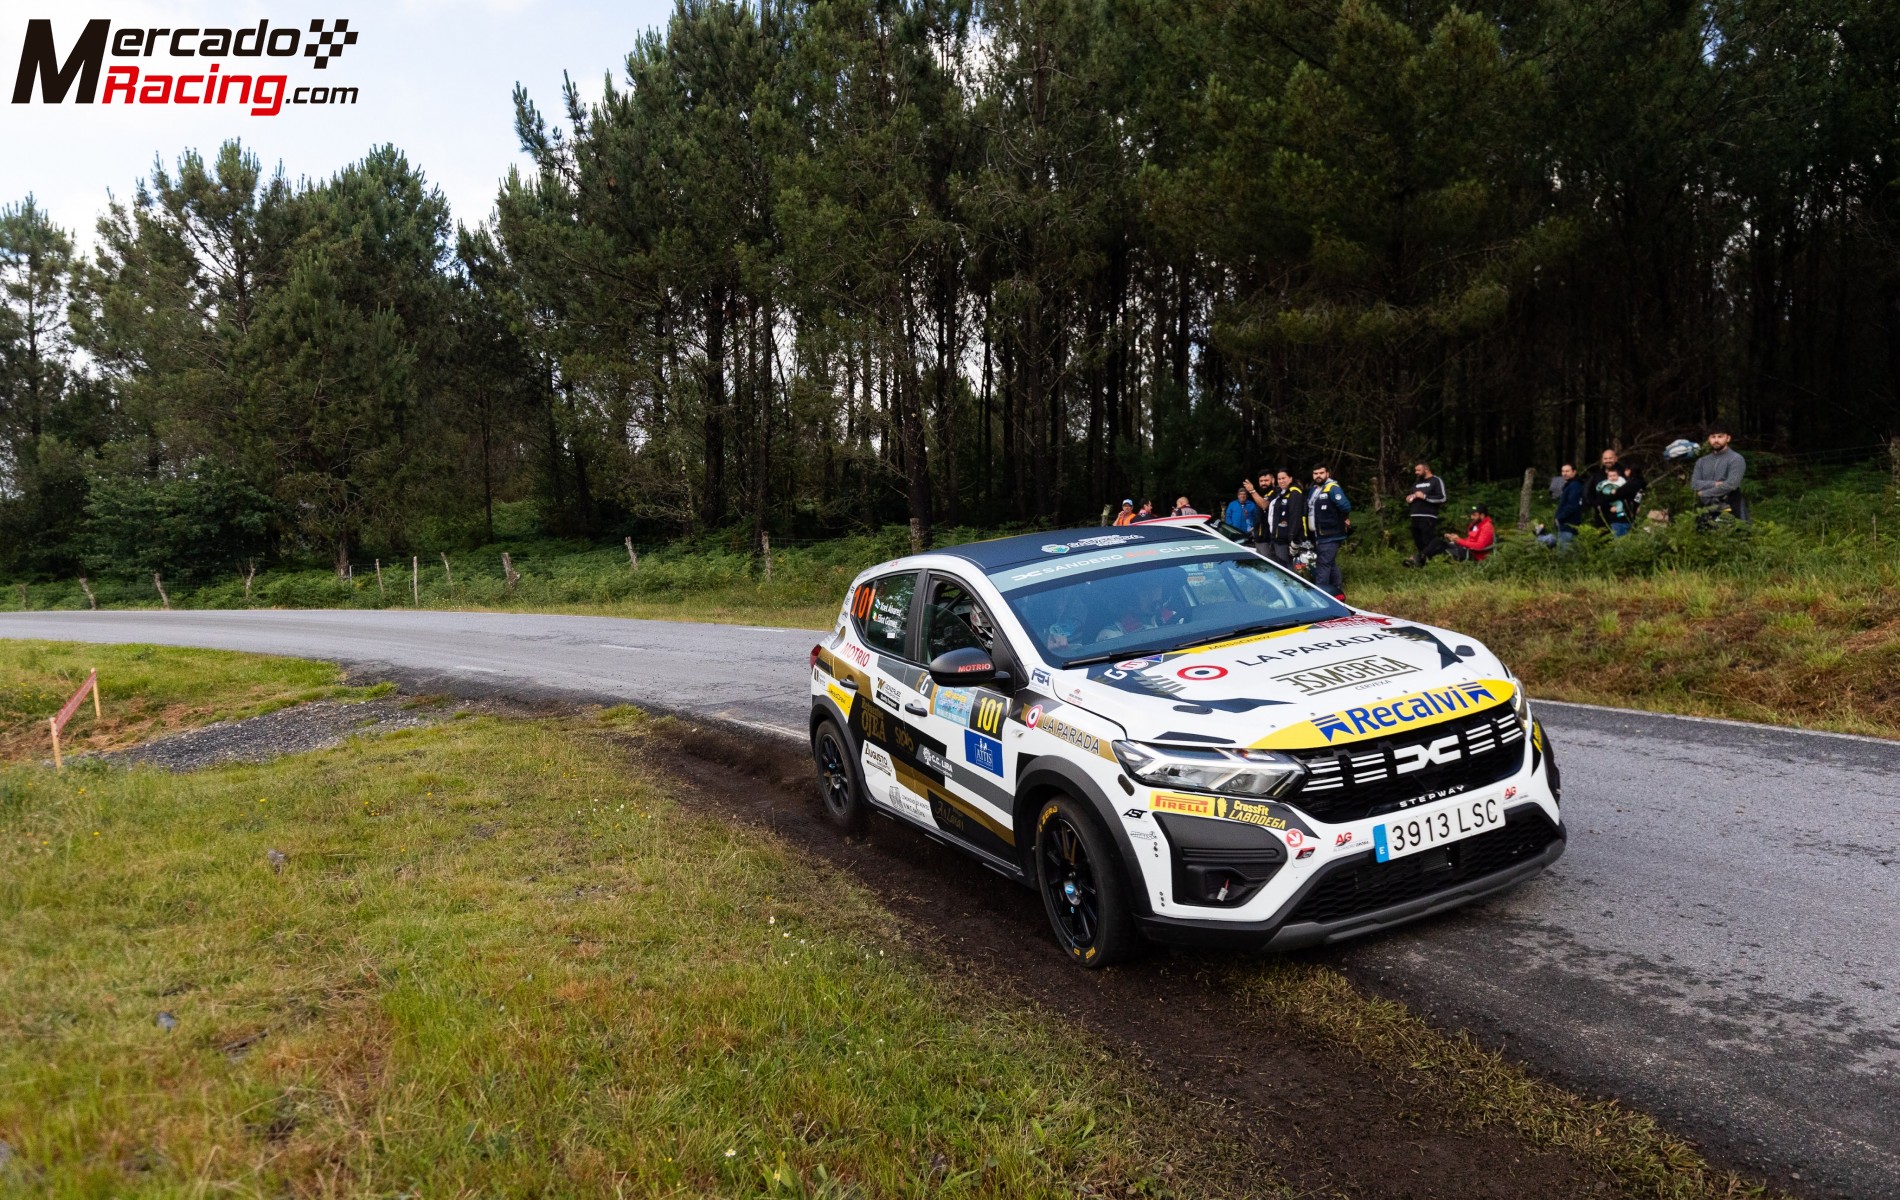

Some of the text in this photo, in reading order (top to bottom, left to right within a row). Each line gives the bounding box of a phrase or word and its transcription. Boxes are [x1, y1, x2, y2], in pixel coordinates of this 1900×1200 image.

[1042, 554, 1124, 573] SANDERO
[1159, 545, 1190, 553] CUP
[850, 585, 876, 620] 101
[841, 642, 871, 668] MOTRIO
[1235, 654, 1282, 666] LA
[1278, 633, 1396, 657] PARADA
[957, 663, 991, 672] MOTRIO
[1354, 679, 1393, 691] CERVEXA
[977, 696, 1004, 735] 101
[1345, 686, 1469, 735] Recalvi
[861, 709, 887, 743] OJEA
[1042, 717, 1101, 754] LA PARADA
[941, 759, 953, 773] LIRA
[1155, 795, 1209, 814] PIRELLI
[1233, 800, 1270, 816] CrossFit
[1399, 785, 1465, 808] STEPWAY
[1042, 805, 1059, 825] ZERO
[1228, 811, 1286, 830] LABODEGA
[1392, 798, 1498, 851] 3913 LSC
[1335, 832, 1353, 846] AG
[1379, 846, 1386, 855] E
